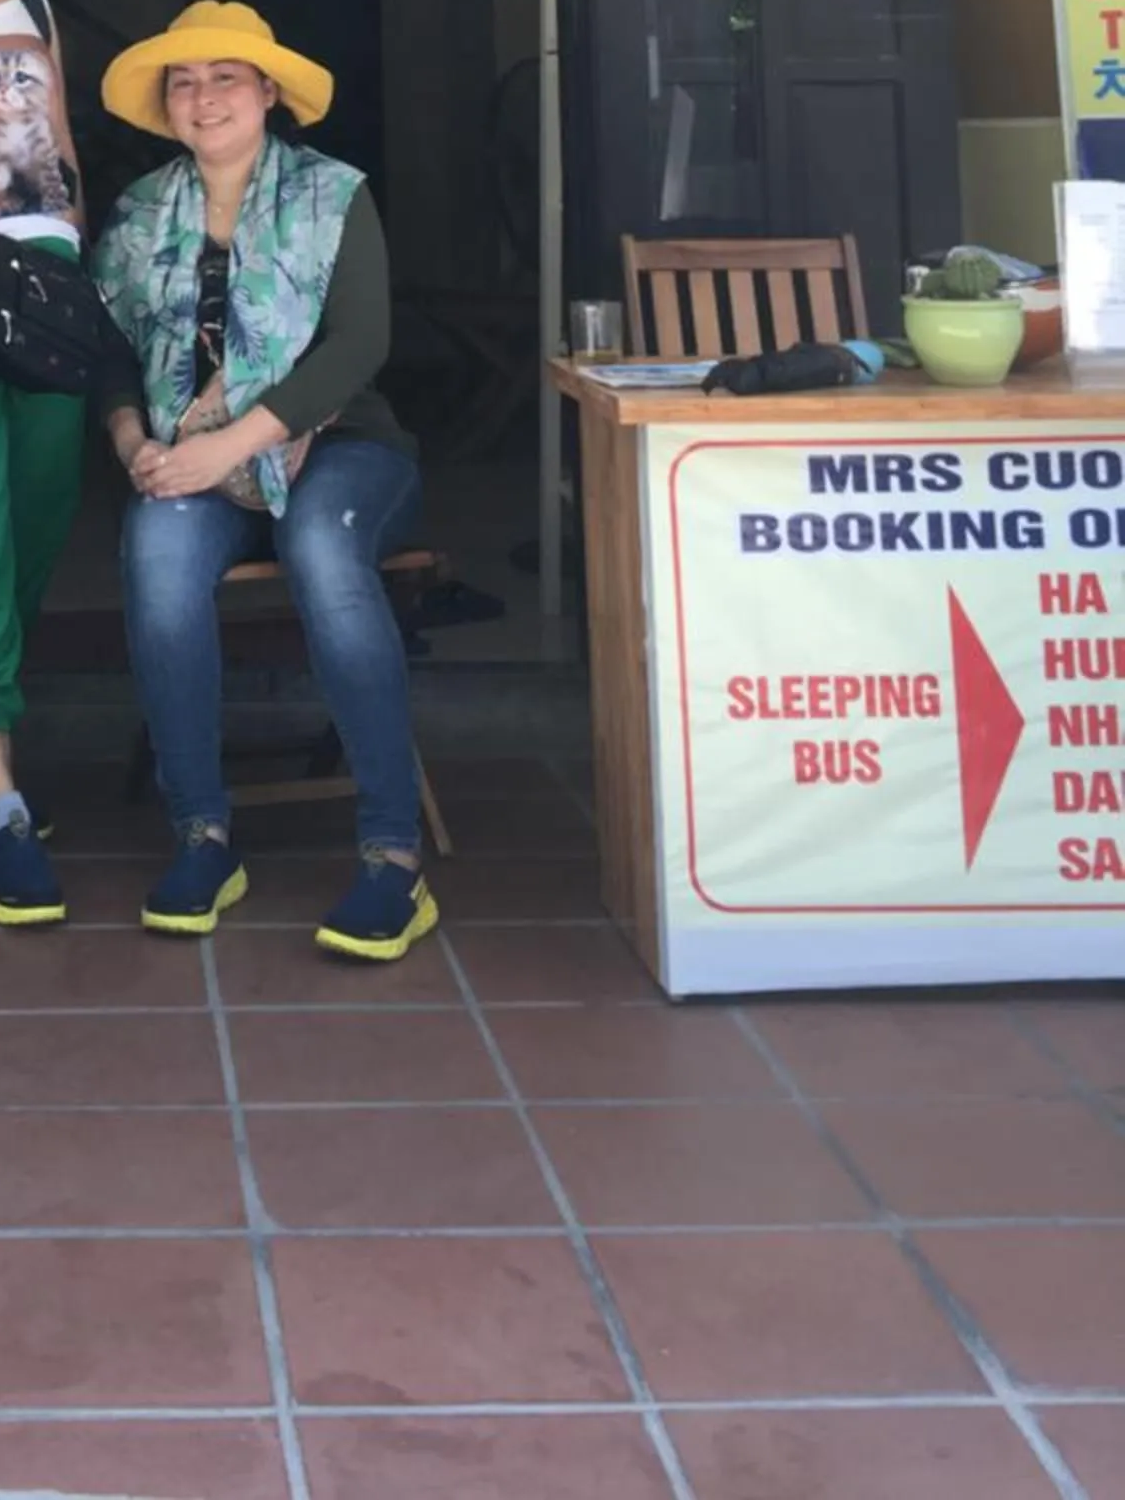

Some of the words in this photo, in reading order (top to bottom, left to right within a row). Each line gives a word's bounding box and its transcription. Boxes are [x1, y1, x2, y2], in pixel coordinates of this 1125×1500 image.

[808, 452, 962, 494] MRS
[987, 450, 1123, 492] CUO
[739, 510, 1044, 553] BOOKING
[1068, 507, 1125, 550] O
[1038, 573, 1108, 615] HA
[727, 674, 941, 720] SLEEPING
[1048, 705, 1125, 747] NH
[793, 739, 882, 785] BUS
[1053, 771, 1125, 813] DA
